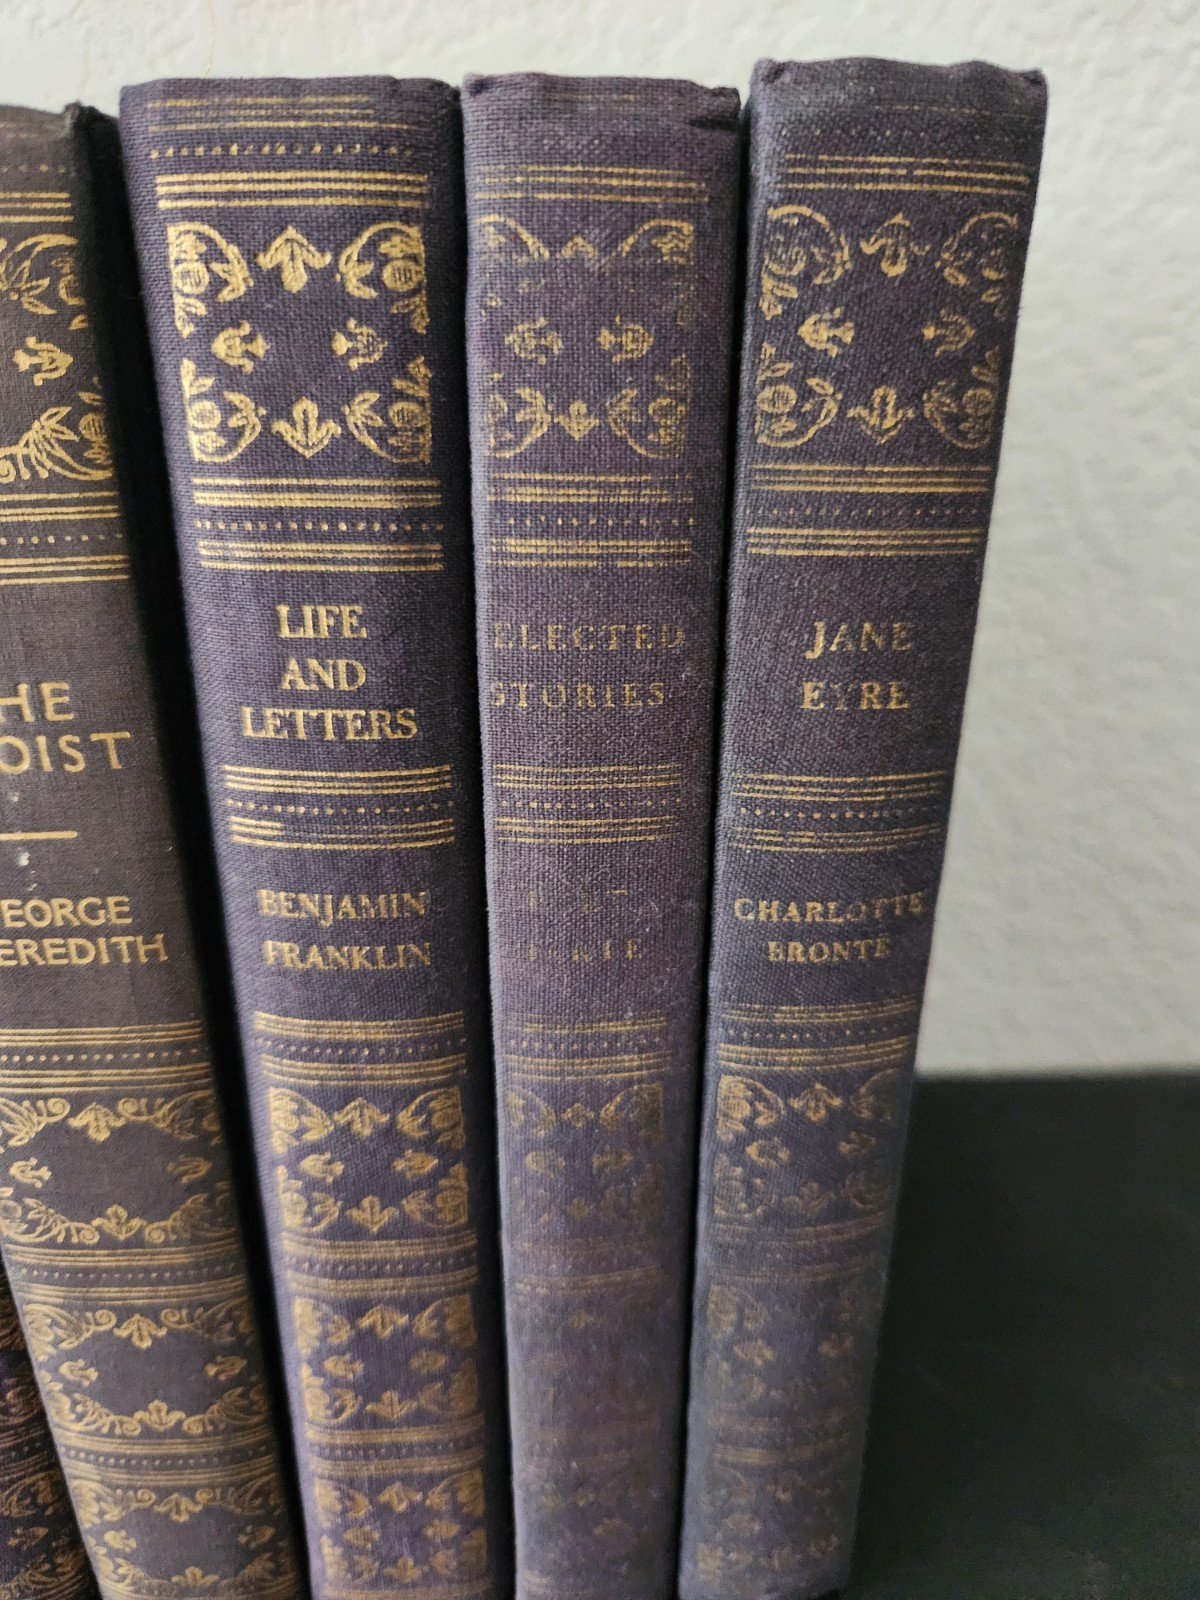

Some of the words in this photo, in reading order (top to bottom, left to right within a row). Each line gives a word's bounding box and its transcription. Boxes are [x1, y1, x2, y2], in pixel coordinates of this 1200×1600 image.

[276, 604, 367, 638] LIFE
[493, 621, 685, 650] ELECTED
[804, 621, 913, 660] JANE
[281, 656, 367, 691] AND
[0, 682, 74, 722] HE
[490, 682, 666, 708] STORIES
[801, 681, 909, 711] EYRE
[240, 706, 418, 740] LETTERS
[0, 731, 131, 774] OIST
[0, 896, 133, 928] EORGE
[256, 888, 426, 927] BENJAMIN
[734, 891, 926, 923] CHARLOTTE
[0, 933, 168, 966] EREDITH
[261, 939, 431, 970] FRANKLIN
